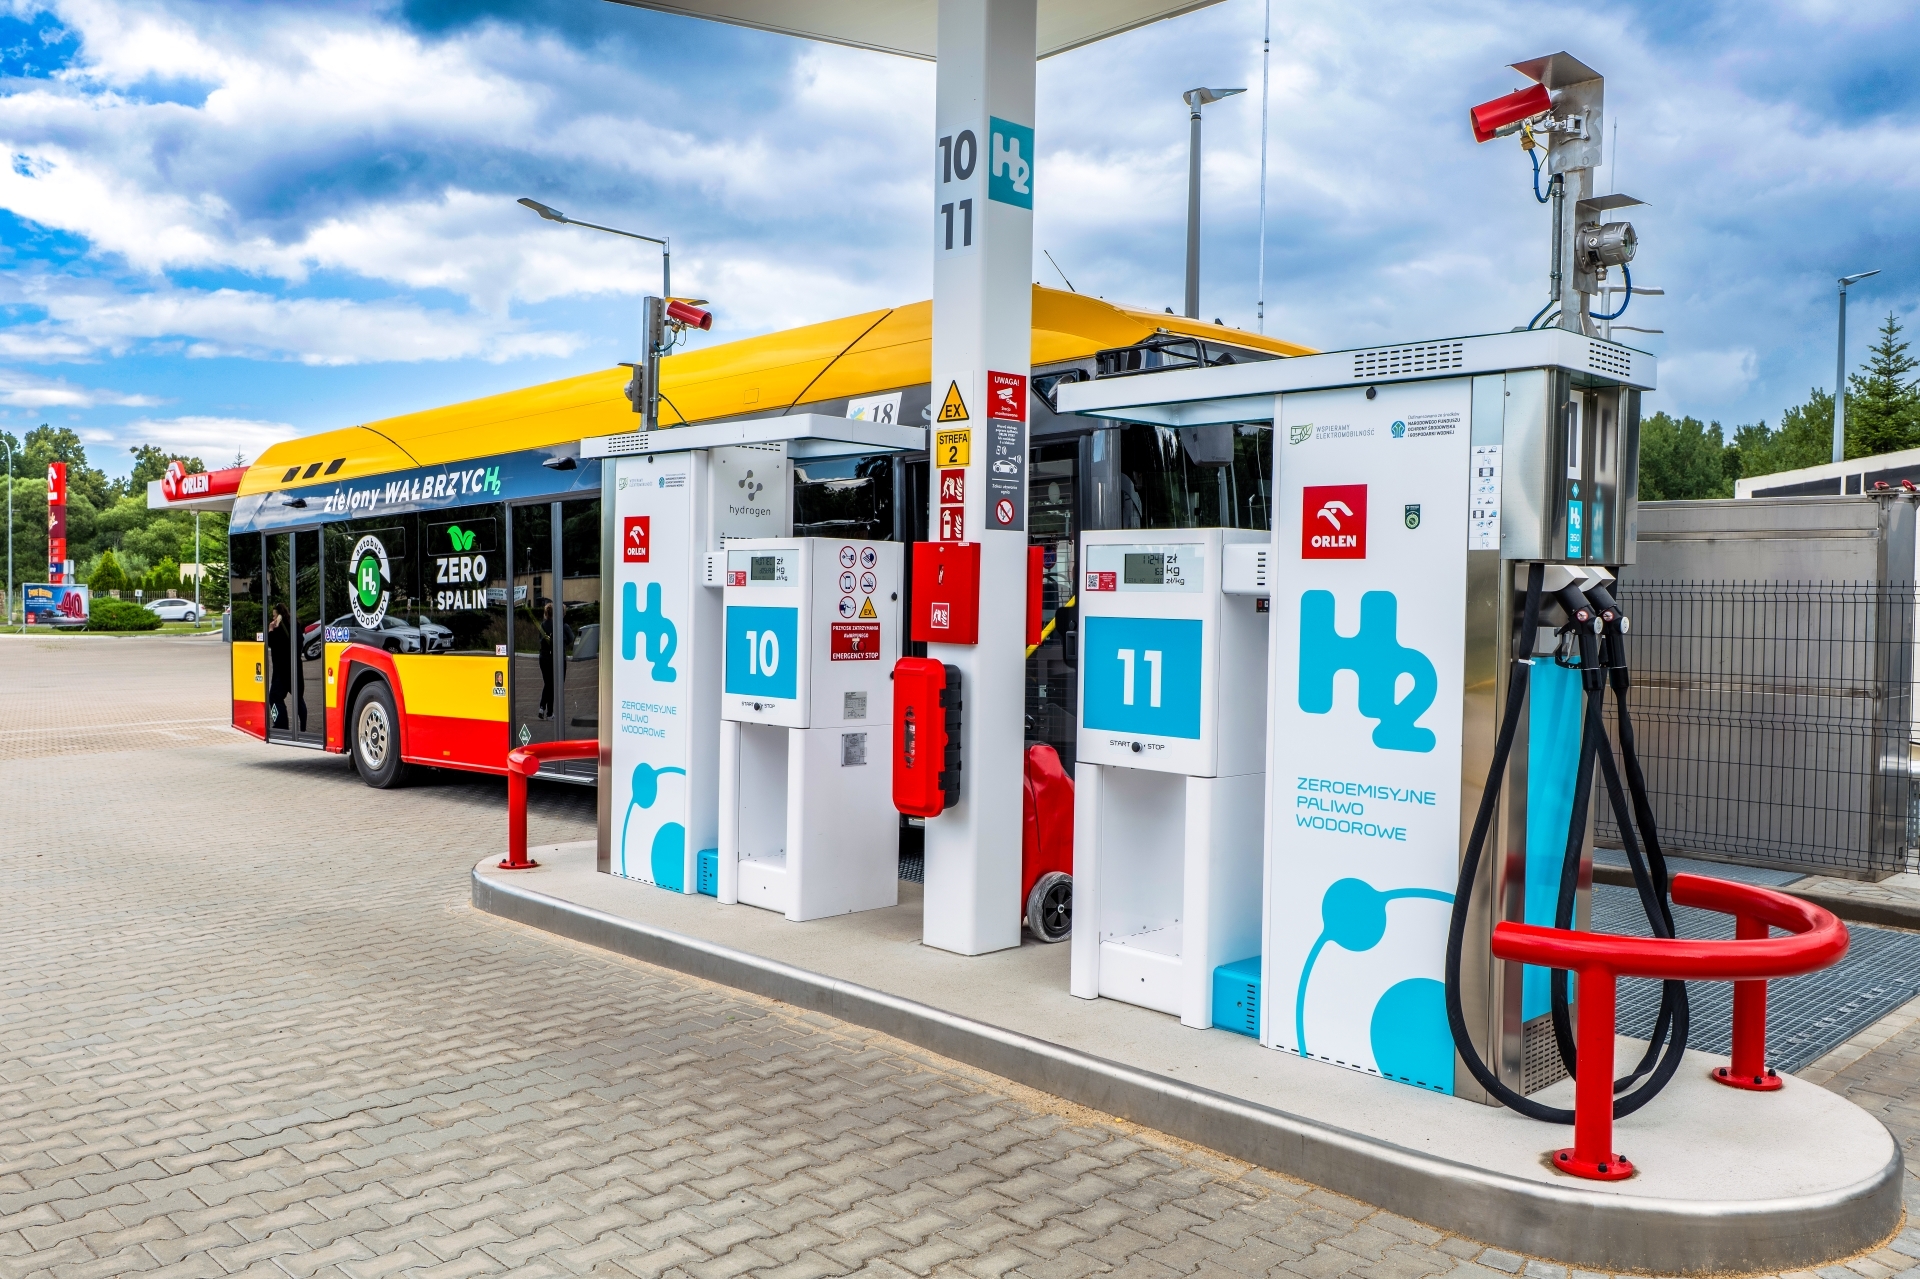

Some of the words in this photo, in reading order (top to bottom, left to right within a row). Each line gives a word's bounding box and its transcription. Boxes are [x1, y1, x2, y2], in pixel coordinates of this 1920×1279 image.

[939, 129, 977, 183] 10
[993, 132, 1030, 194] H2
[941, 198, 973, 250] 11
[994, 376, 1020, 386] UWAGA!
[945, 404, 961, 418] EX
[1315, 428, 1375, 440] ELEKTROMOBILNOŚĆ
[1316, 424, 1350, 432] WSPIERAMY
[939, 433, 968, 445] STREFA
[949, 446, 958, 463] 2
[181, 475, 210, 494] ORLEN
[323, 484, 381, 513] zielony
[729, 505, 771, 517] hydrogen
[1311, 535, 1357, 548] ORLEN
[1569, 533, 1580, 542] 350
[356, 538, 382, 557] autobus
[1569, 544, 1579, 552] bar
[1166, 554, 1177, 563] zł
[436, 555, 487, 583] ZERO
[776, 566, 785, 575] kg
[1166, 565, 1180, 576] kg
[362, 568, 377, 594] H2
[436, 589, 488, 610] SPALIN
[352, 596, 387, 625] WODOROWY
[622, 582, 678, 683] H2
[746, 630, 779, 677] 10
[1117, 649, 1162, 707] 11
[1298, 590, 1438, 753] H2
[621, 701, 677, 715] ZEROEMISYJNE
[621, 712, 648, 723] PALIWO
[621, 724, 665, 738] WODOROWE
[1297, 777, 1436, 806] ZEROEMISYJNE
[1297, 795, 1364, 816] PALIWO
[1296, 814, 1406, 841] WODOROWE
